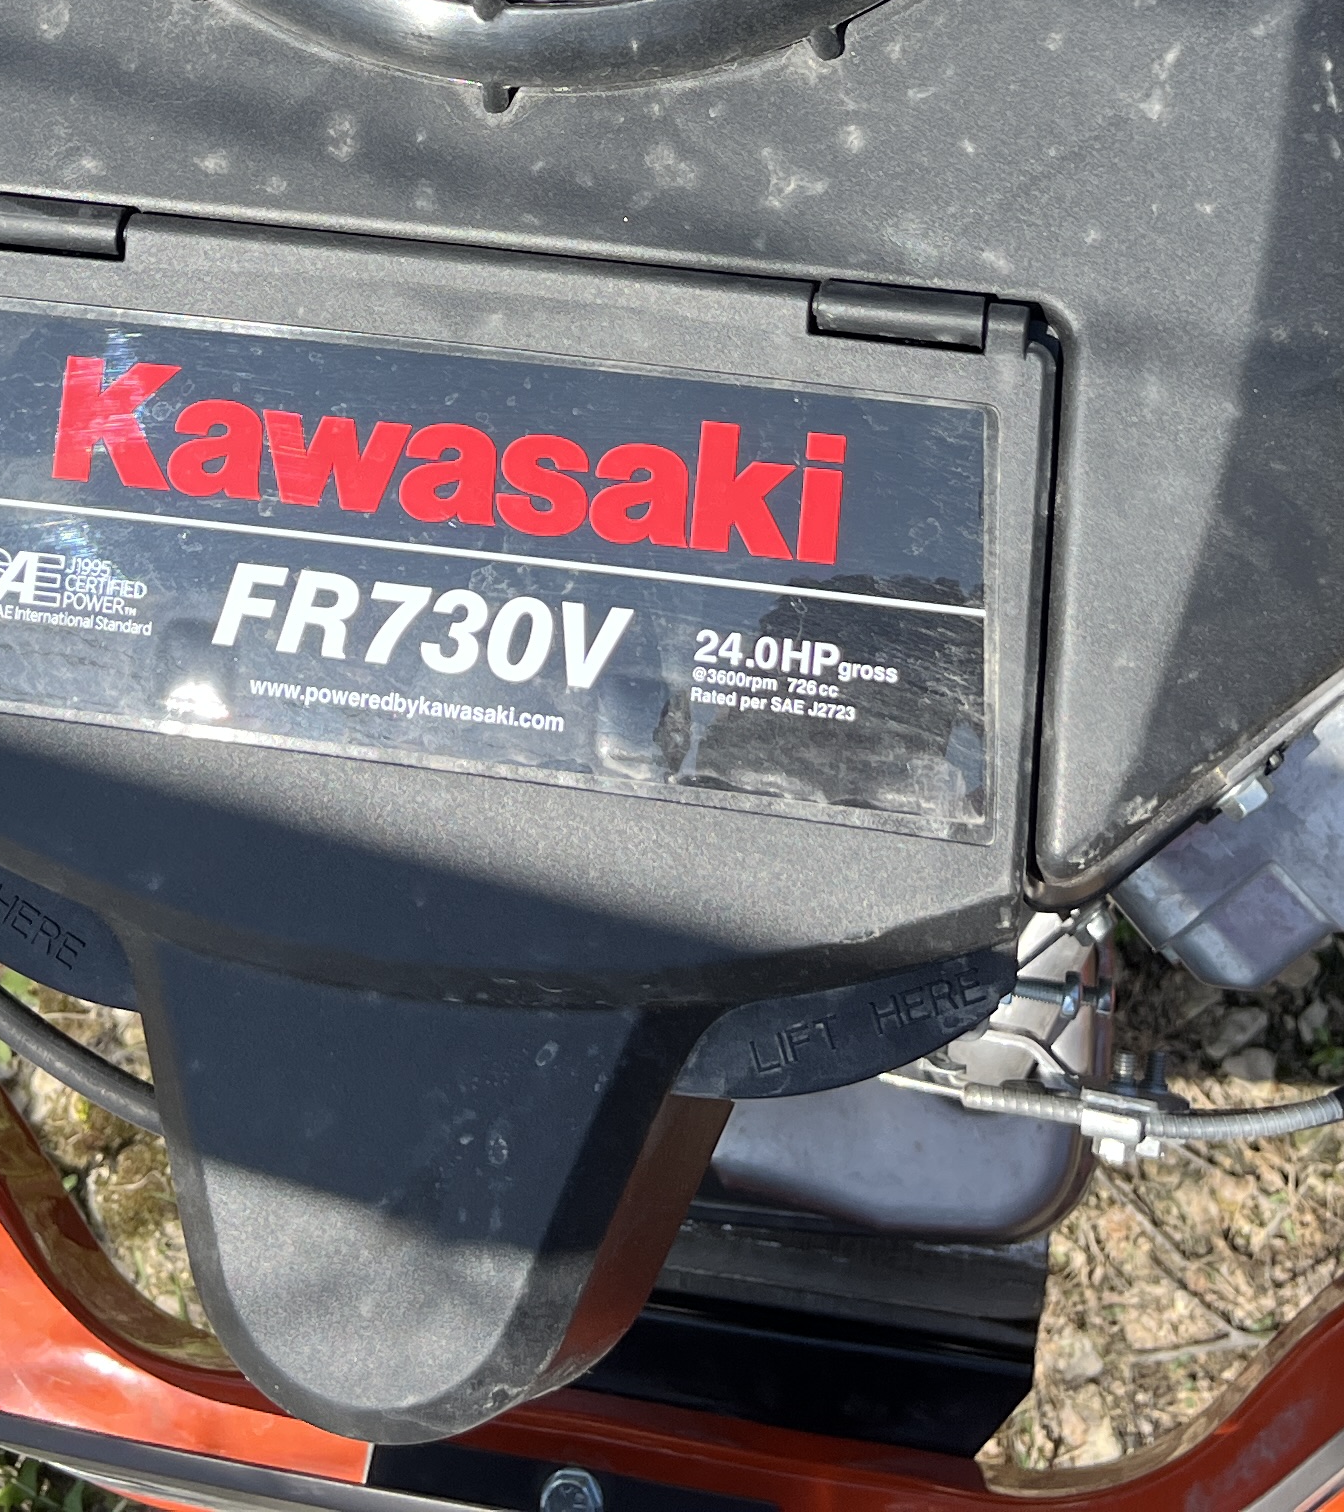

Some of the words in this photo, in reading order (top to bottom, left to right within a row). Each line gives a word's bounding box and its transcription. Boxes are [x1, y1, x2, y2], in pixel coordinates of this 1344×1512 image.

[51, 355, 847, 565] Kawasaki
[64, 557, 113, 577] J1995
[64, 575, 148, 599] CERTIFIED
[14, 605, 94, 629] International
[94, 615, 153, 636] Standard
[211, 562, 634, 689] FR730V
[692, 666, 778, 692] @3600rpm
[249, 677, 565, 732] www.poweredbykawasaki.com
[690, 686, 737, 706] Rated
[739, 695, 768, 711] per
[770, 696, 805, 715] SAE
[807, 701, 856, 722] J2723
[749, 1014, 837, 1074] LIFT
[867, 967, 987, 1036] HERE
